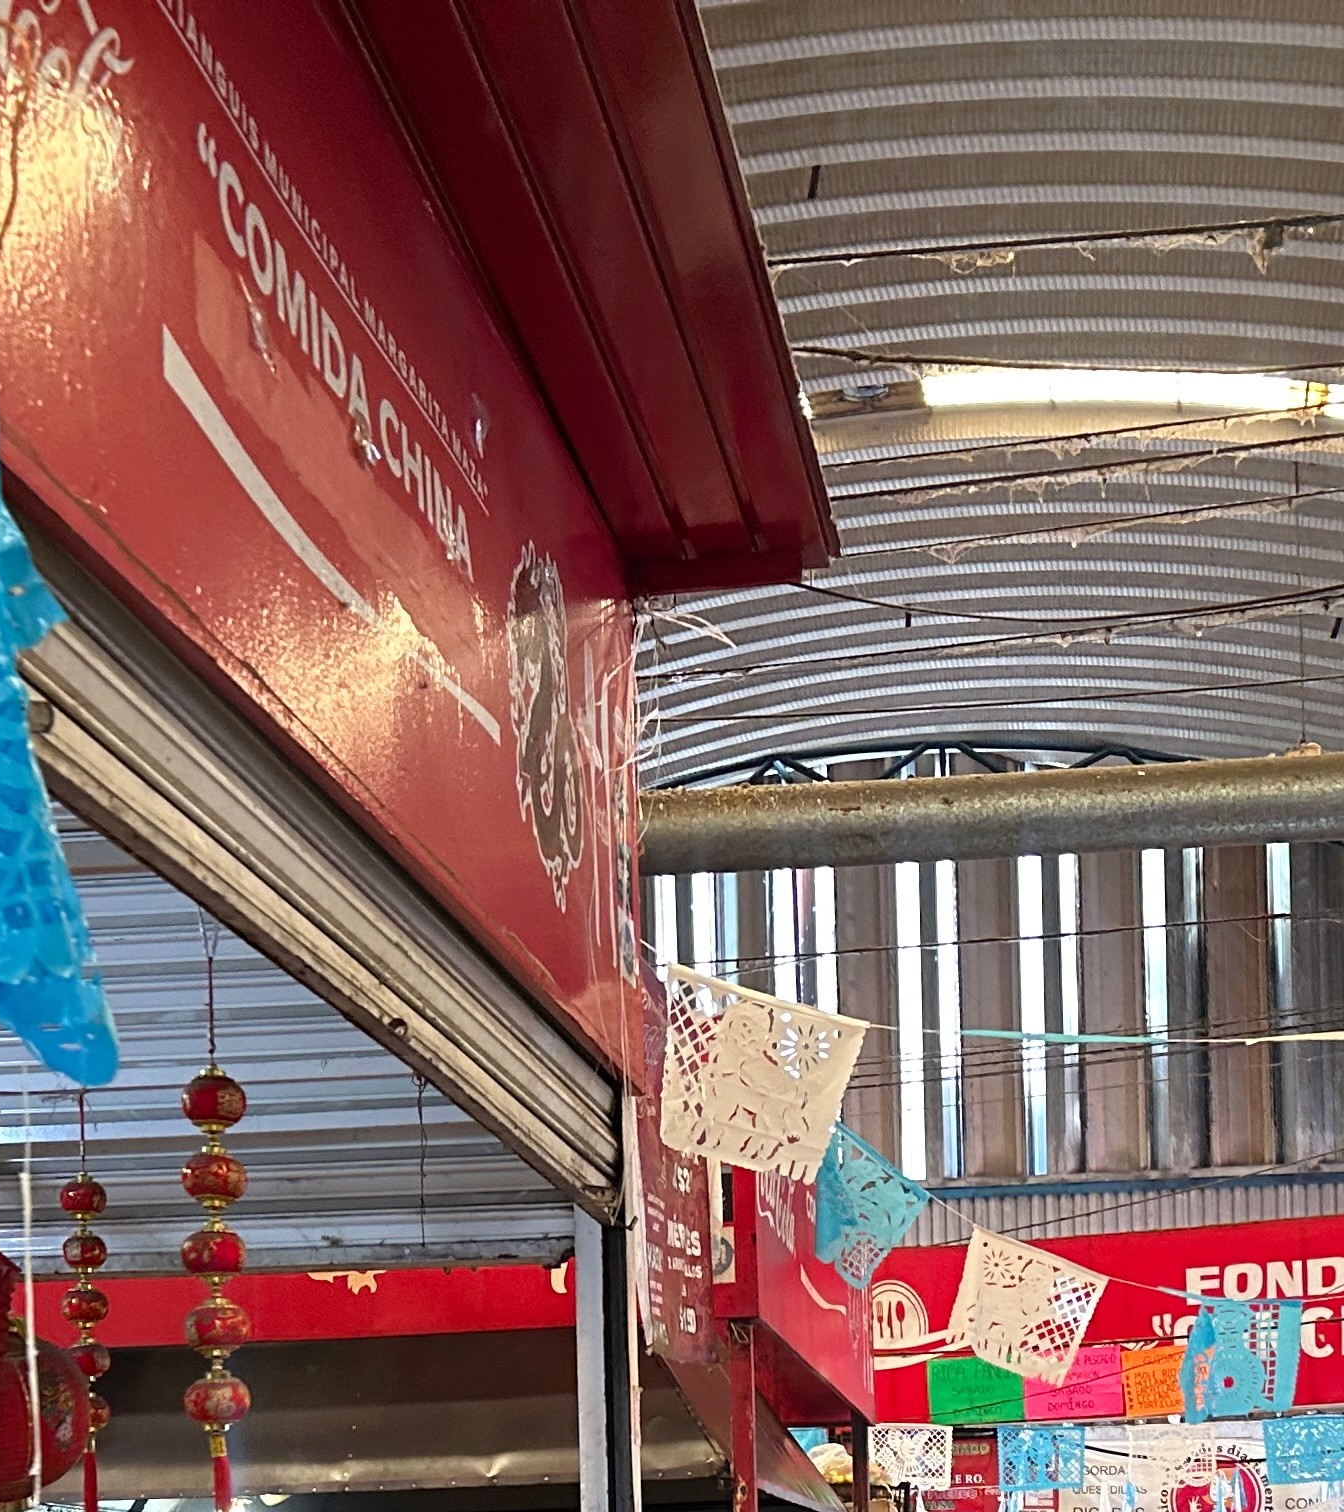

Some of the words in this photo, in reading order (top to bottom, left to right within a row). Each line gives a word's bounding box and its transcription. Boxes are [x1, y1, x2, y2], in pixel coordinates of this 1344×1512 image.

[168, 0, 259, 150] IANGUIS
[264, 142, 360, 308] MUNICIPAL
[364, 297, 449, 442] MARGARITA
[1067, 1370, 1099, 1381] AMARON
